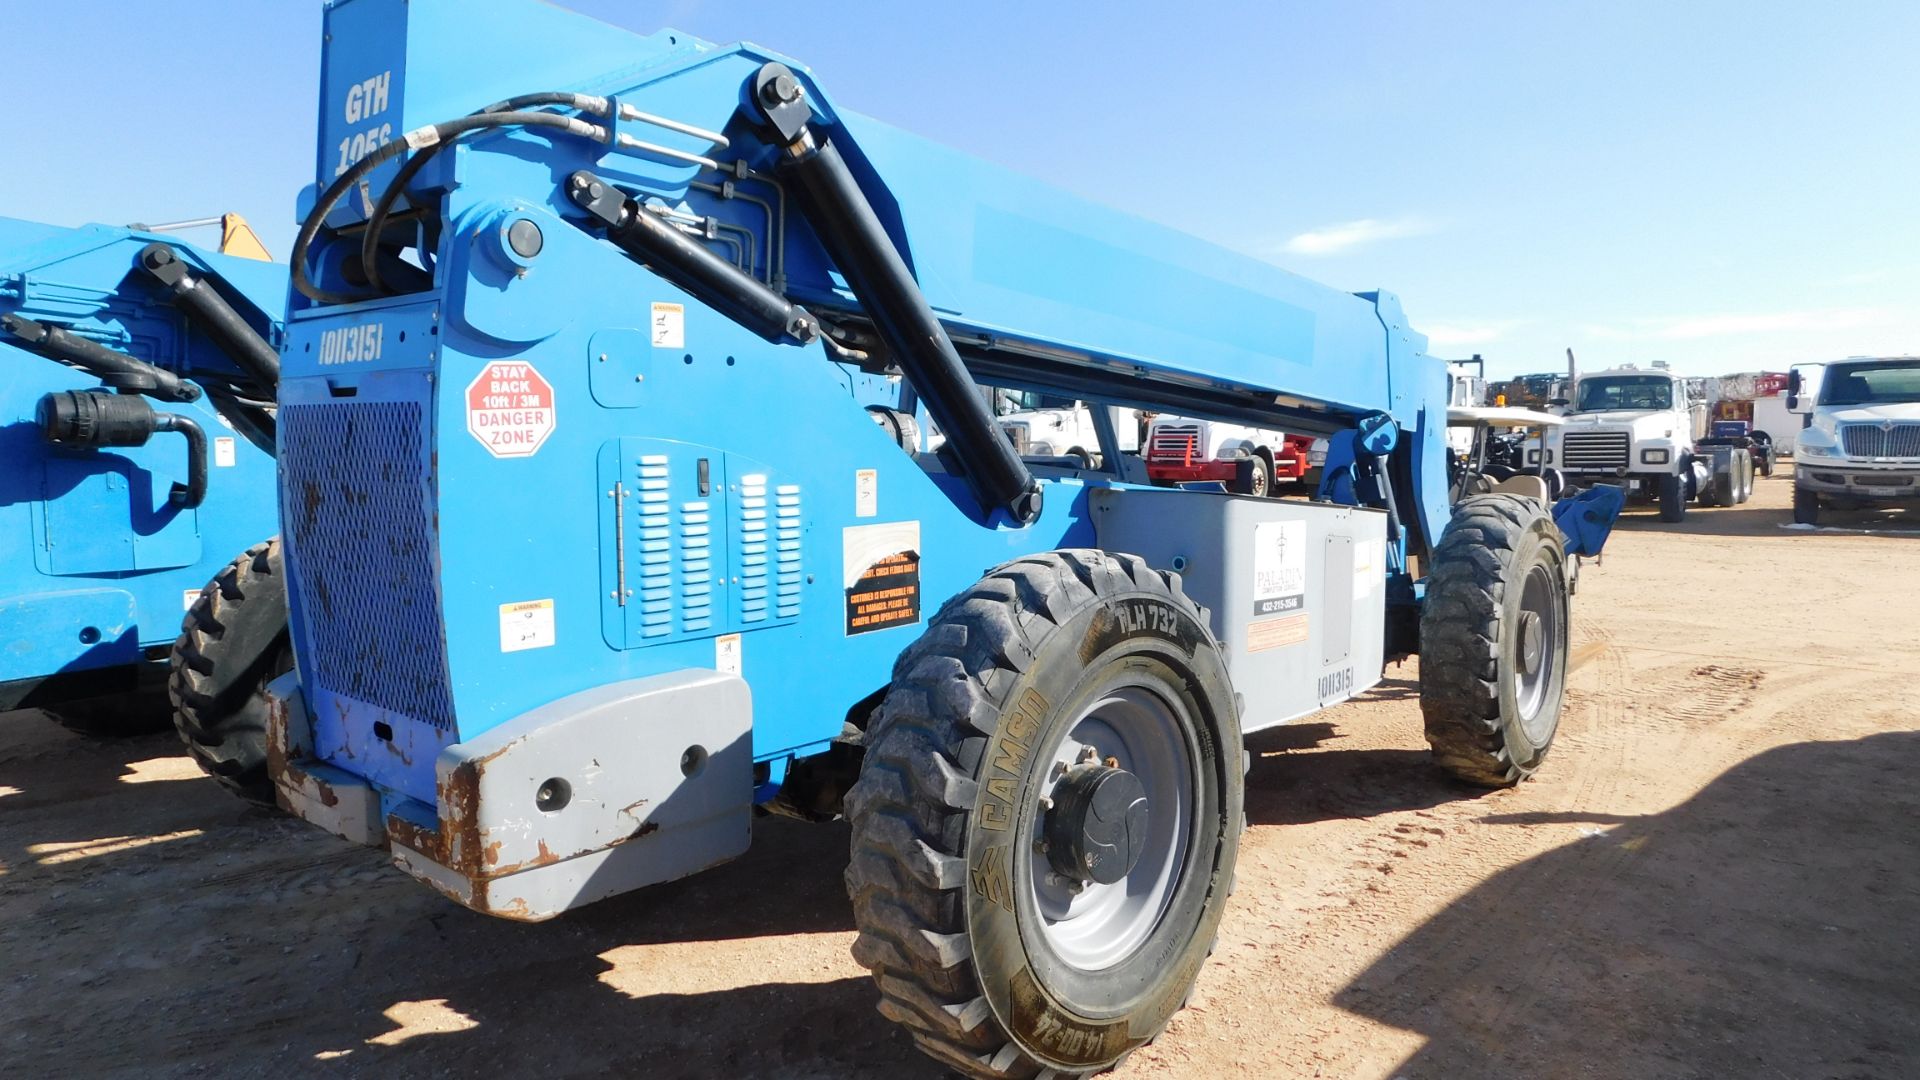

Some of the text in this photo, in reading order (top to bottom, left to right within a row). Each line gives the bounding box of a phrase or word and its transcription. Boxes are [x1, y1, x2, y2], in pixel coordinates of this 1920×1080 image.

[345, 70, 391, 125] GTH
[491, 366, 527, 379] STAY
[490, 380, 531, 393] BACK
[482, 394, 540, 409] 10ft / 3M
[479, 411, 544, 427] DANGER
[491, 430, 535, 445] ZONE
[1257, 567, 1302, 588] PALADIN
[1148, 604, 1178, 637] 732
[980, 687, 1050, 832] CAMSO
